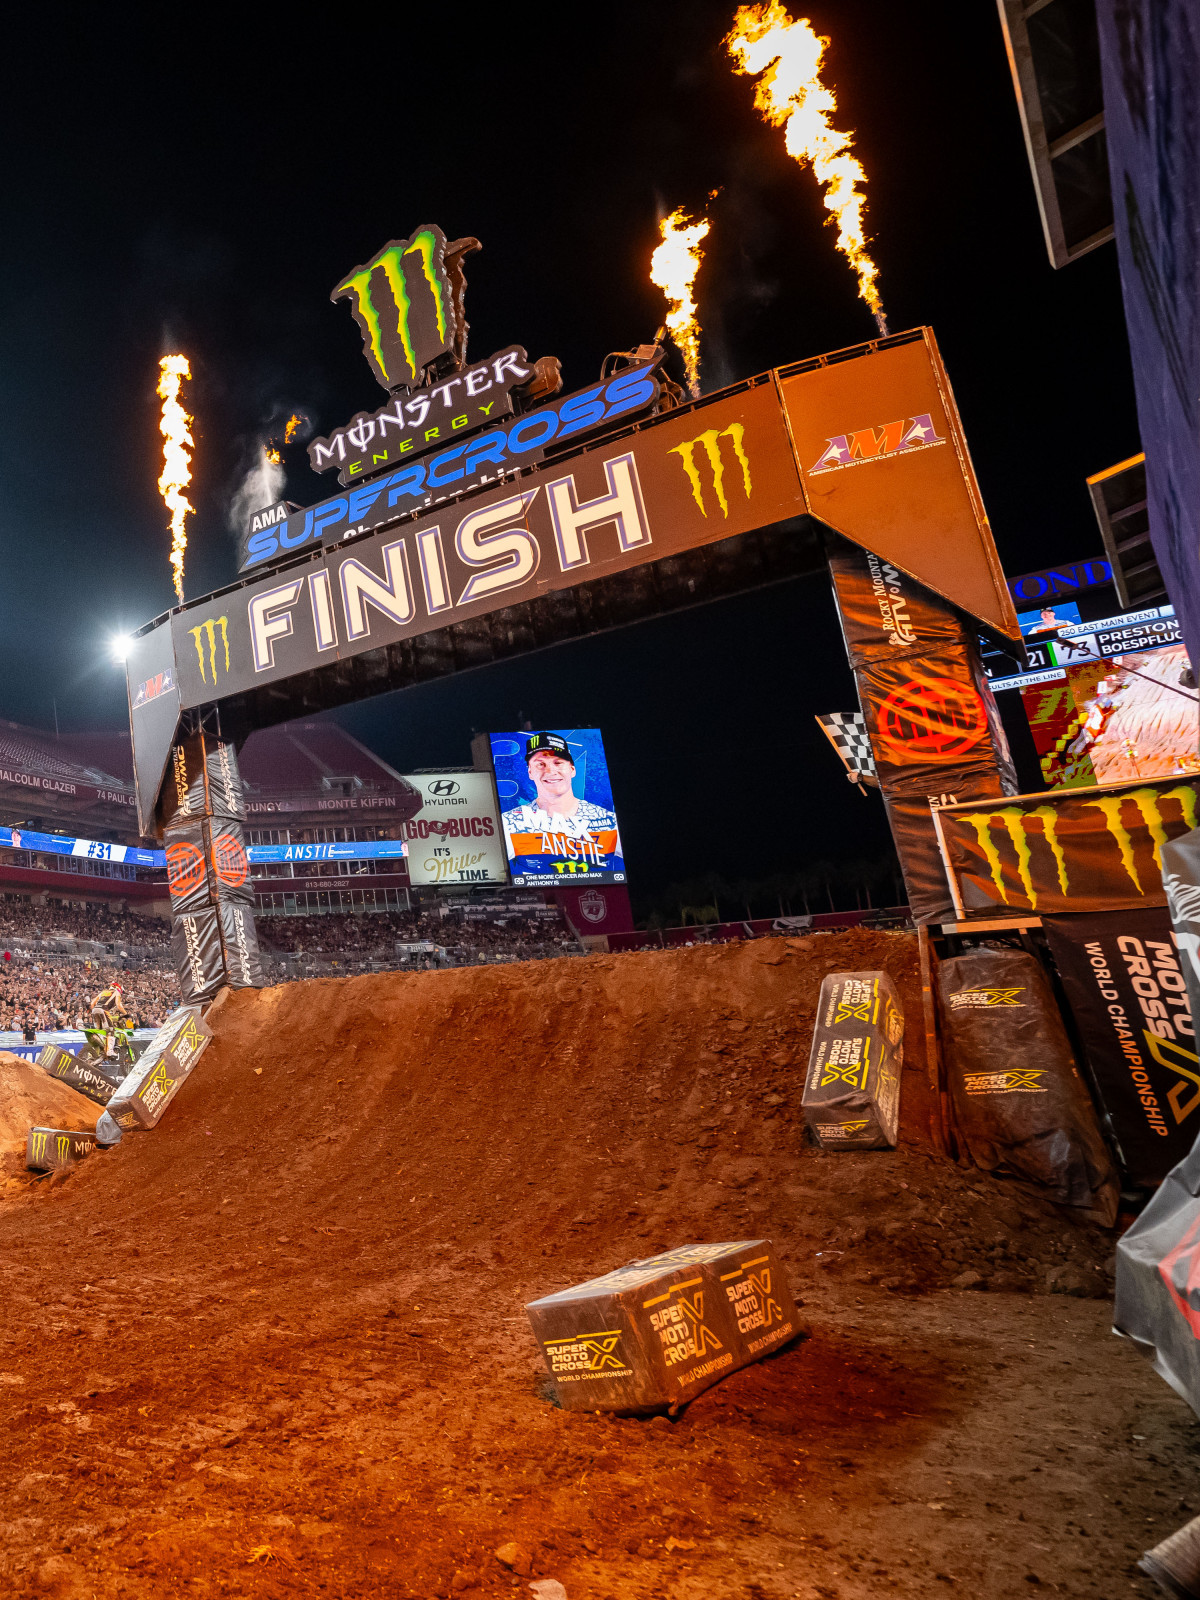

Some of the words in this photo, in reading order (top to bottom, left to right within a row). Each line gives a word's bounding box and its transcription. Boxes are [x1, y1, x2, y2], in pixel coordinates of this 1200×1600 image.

[314, 349, 531, 466] MONSTER
[349, 400, 495, 475] ENERGY
[807, 413, 946, 473] AMA
[246, 363, 657, 566] SUPERCROSS
[809, 464, 845, 477] AMERICAN
[845, 452, 898, 468] MOTORCYCLIST
[898, 440, 947, 455] ASSOCIATION
[252, 504, 287, 533] AMA
[248, 451, 653, 673] FINISH
[1007, 560, 1114, 601] OND
[878, 598, 896, 631] ROCKY
[1060, 627, 1076, 637] 250
[1077, 622, 1099, 634] EAST
[1101, 617, 1124, 629] MAIN
[1125, 610, 1156, 624] EVENT
[1098, 619, 1180, 644] PRESTON
[1028, 650, 1045, 668] 21
[132, 668, 176, 707] AMA
[1024, 676, 1042, 685] THE
[1043, 672, 1062, 682] LINE
[42, 778, 77, 795] GLAZER
[96, 789, 106, 800] 74
[107, 791, 128, 805] PAUL
[176, 783, 185, 806] ROCKY
[318, 798, 358, 810] MONTE
[360, 796, 396, 809] KIFFIN
[424, 797, 468, 806] HYUNDAI
[406, 818, 430, 840] GO
[448, 816, 495, 838] BUCS
[521, 804, 596, 843] MAX
[87, 841, 112, 860] #31
[285, 844, 335, 860] ANSTIE
[433, 847, 451, 857] IT'S
[541, 832, 608, 868] ANSTIE
[423, 851, 487, 881] Miller
[458, 868, 490, 882] TIME
[305, 880, 350, 889] 813-680-2827
[182, 918, 194, 957] MOUNTAIN
[189, 958, 198, 982] ROCKY
[841, 979, 852, 1005] CROSS
[850, 979, 862, 1004] MOTO
[860, 979, 872, 1004] SUPER
[1116, 935, 1177, 1040] CROSS
[849, 1037, 863, 1065] SUPER
[1084, 941, 1120, 1001] WORLD
[1107, 1004, 1169, 1137] CHAMPIONSHIP
[829, 1039, 843, 1066] CROSS
[839, 1040, 852, 1065] MOTO
[73, 1064, 118, 1096] MONSTE
[963, 1074, 1008, 1083] SUPER
[725, 1279, 755, 1303] SUPER
[650, 1303, 686, 1332] SUPER
[735, 1296, 758, 1314] MOTO
[737, 1311, 765, 1335] CROSS
[546, 1343, 588, 1357] SUPER
[552, 1351, 589, 1363] MOTO
[663, 1337, 697, 1367] CROSS
[552, 1360, 591, 1372] CROSS
[556, 1374, 580, 1383] WORLD
[581, 1369, 634, 1381] CHAMPIONSHIP
[694, 1352, 734, 1380] CHAMPIONSHIP
